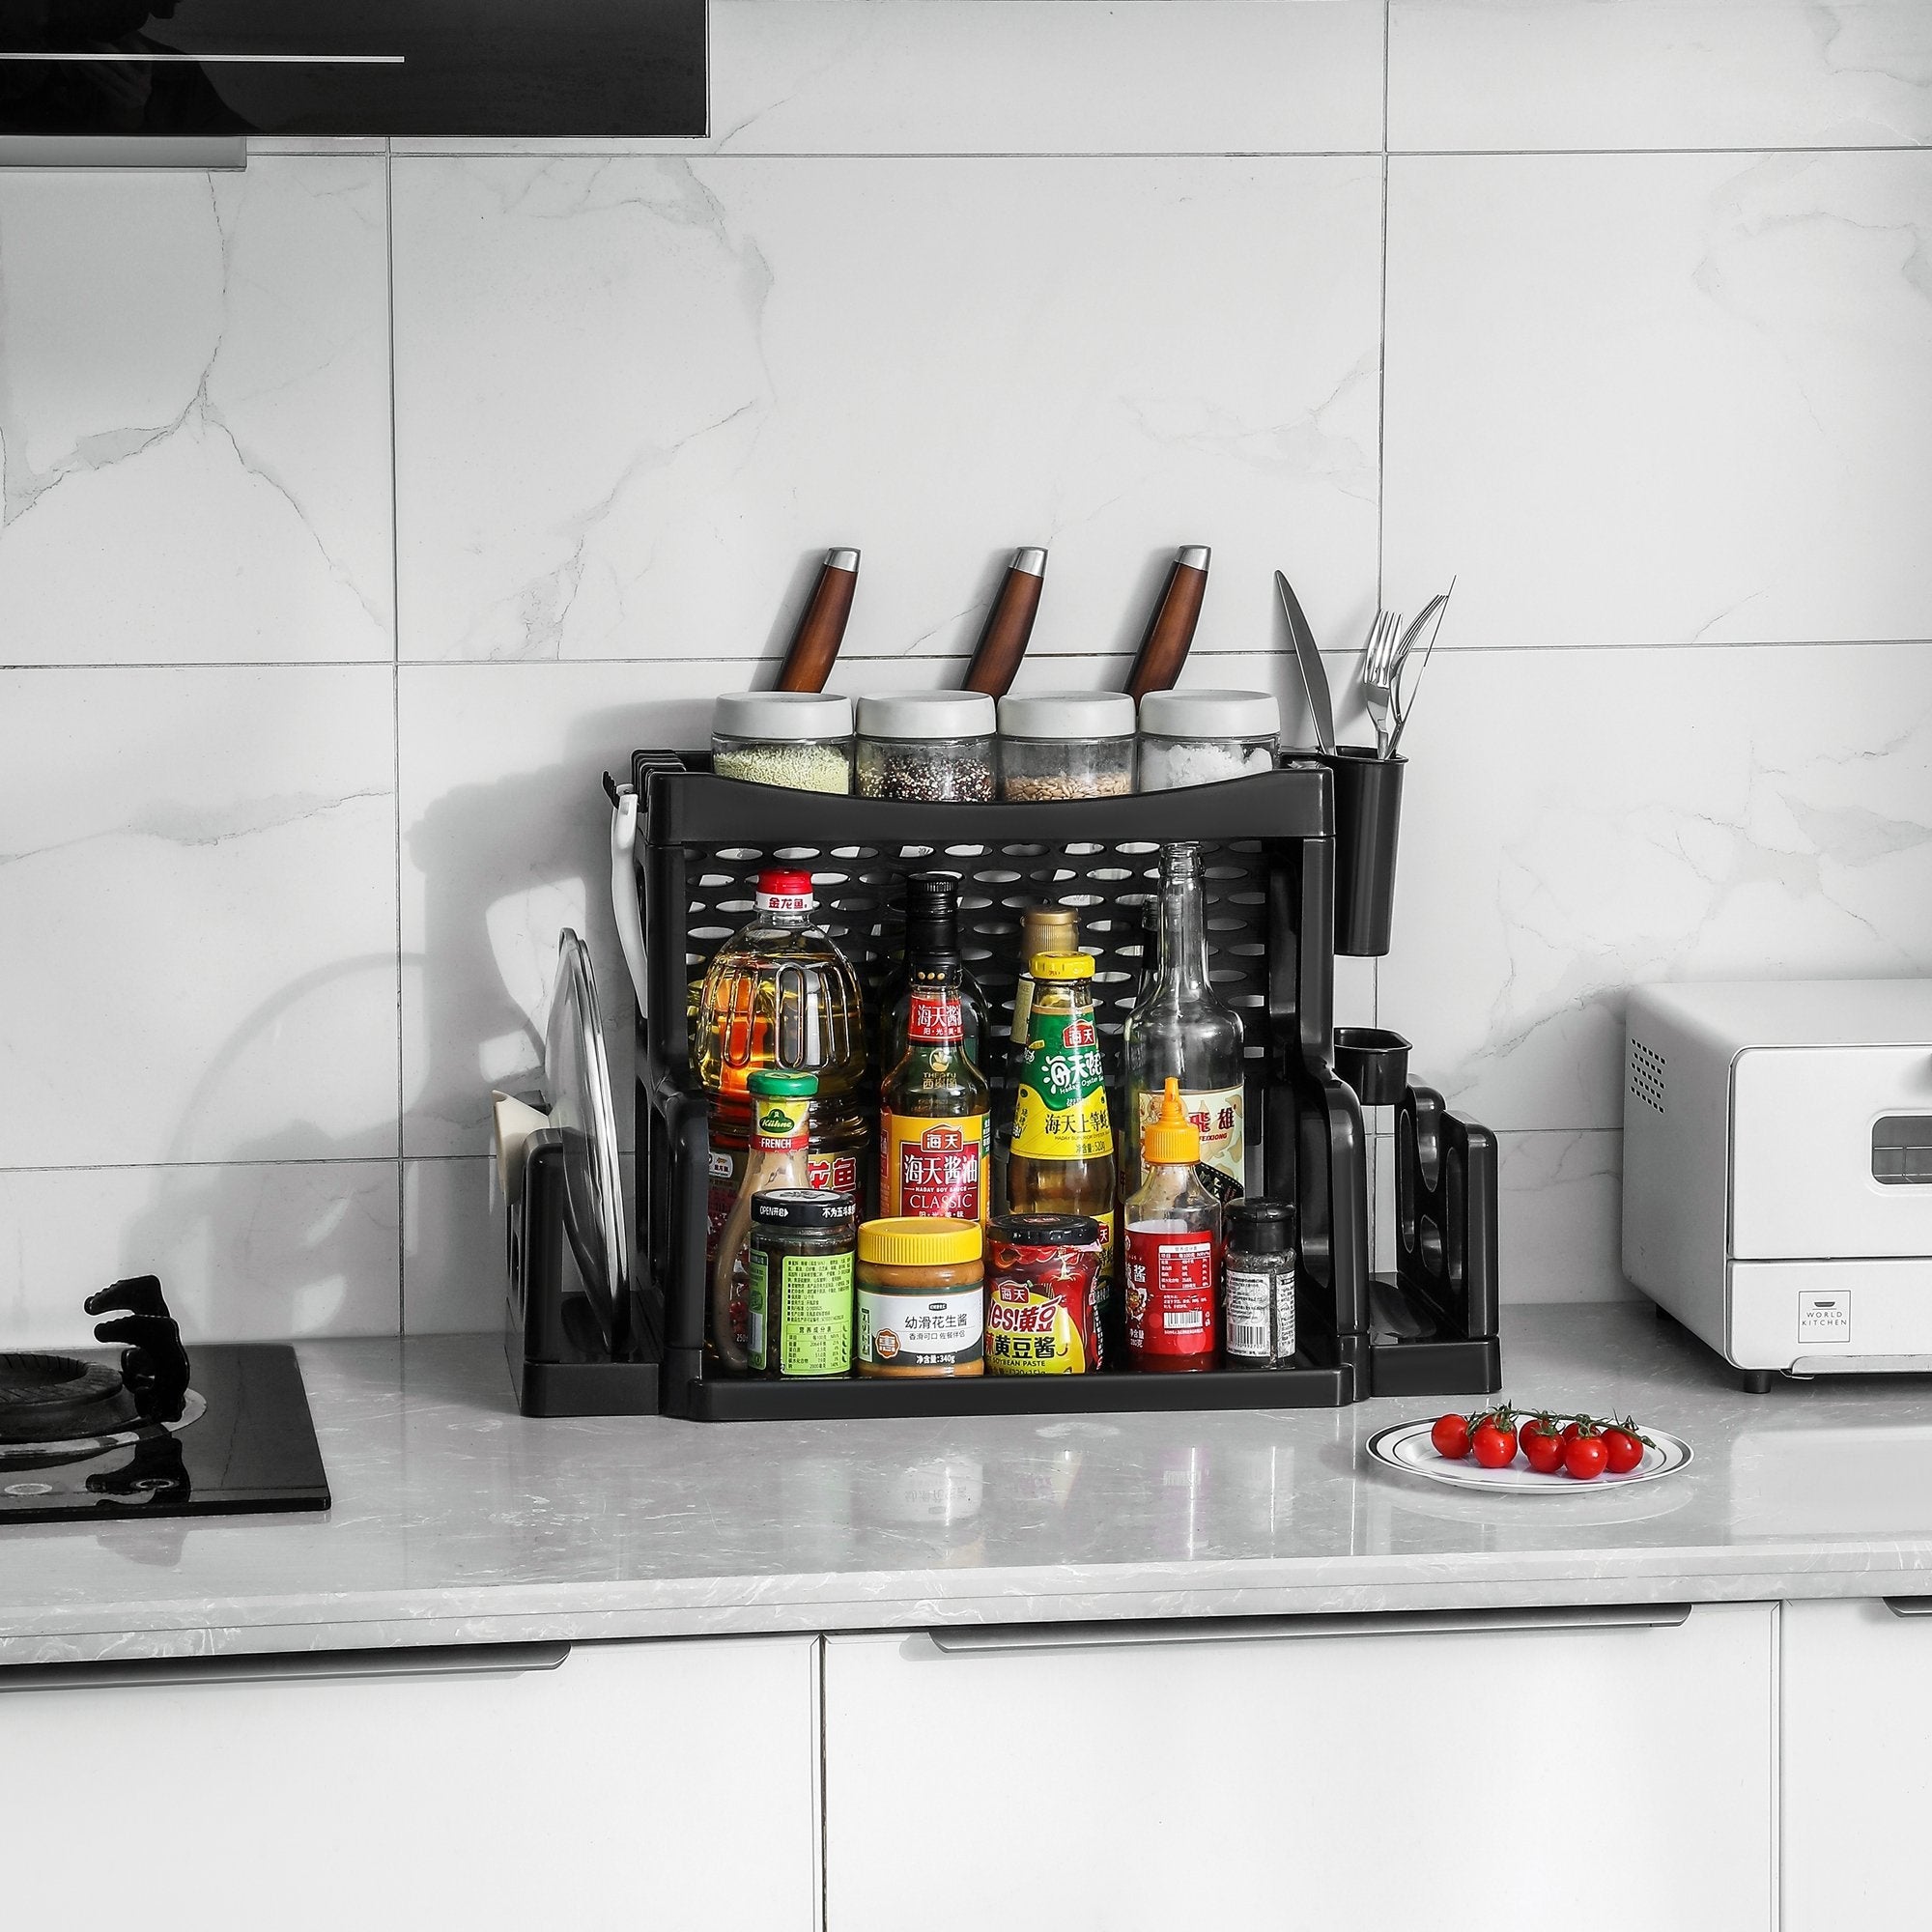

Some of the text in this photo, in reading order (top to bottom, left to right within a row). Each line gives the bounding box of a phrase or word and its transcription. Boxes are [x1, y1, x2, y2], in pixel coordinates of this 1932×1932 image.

[769, 897, 804, 909] 金龙鱼
[1068, 1028, 1094, 1044] 海天
[761, 1138, 792, 1149] FRENCH
[926, 1133, 958, 1150] 海天
[904, 1154, 978, 1185] 海天酱油
[909, 1194, 973, 1209] CLASSIC
[1002, 1287, 1026, 1301] 海天
[905, 1313, 967, 1329] 幼滑花生酱
